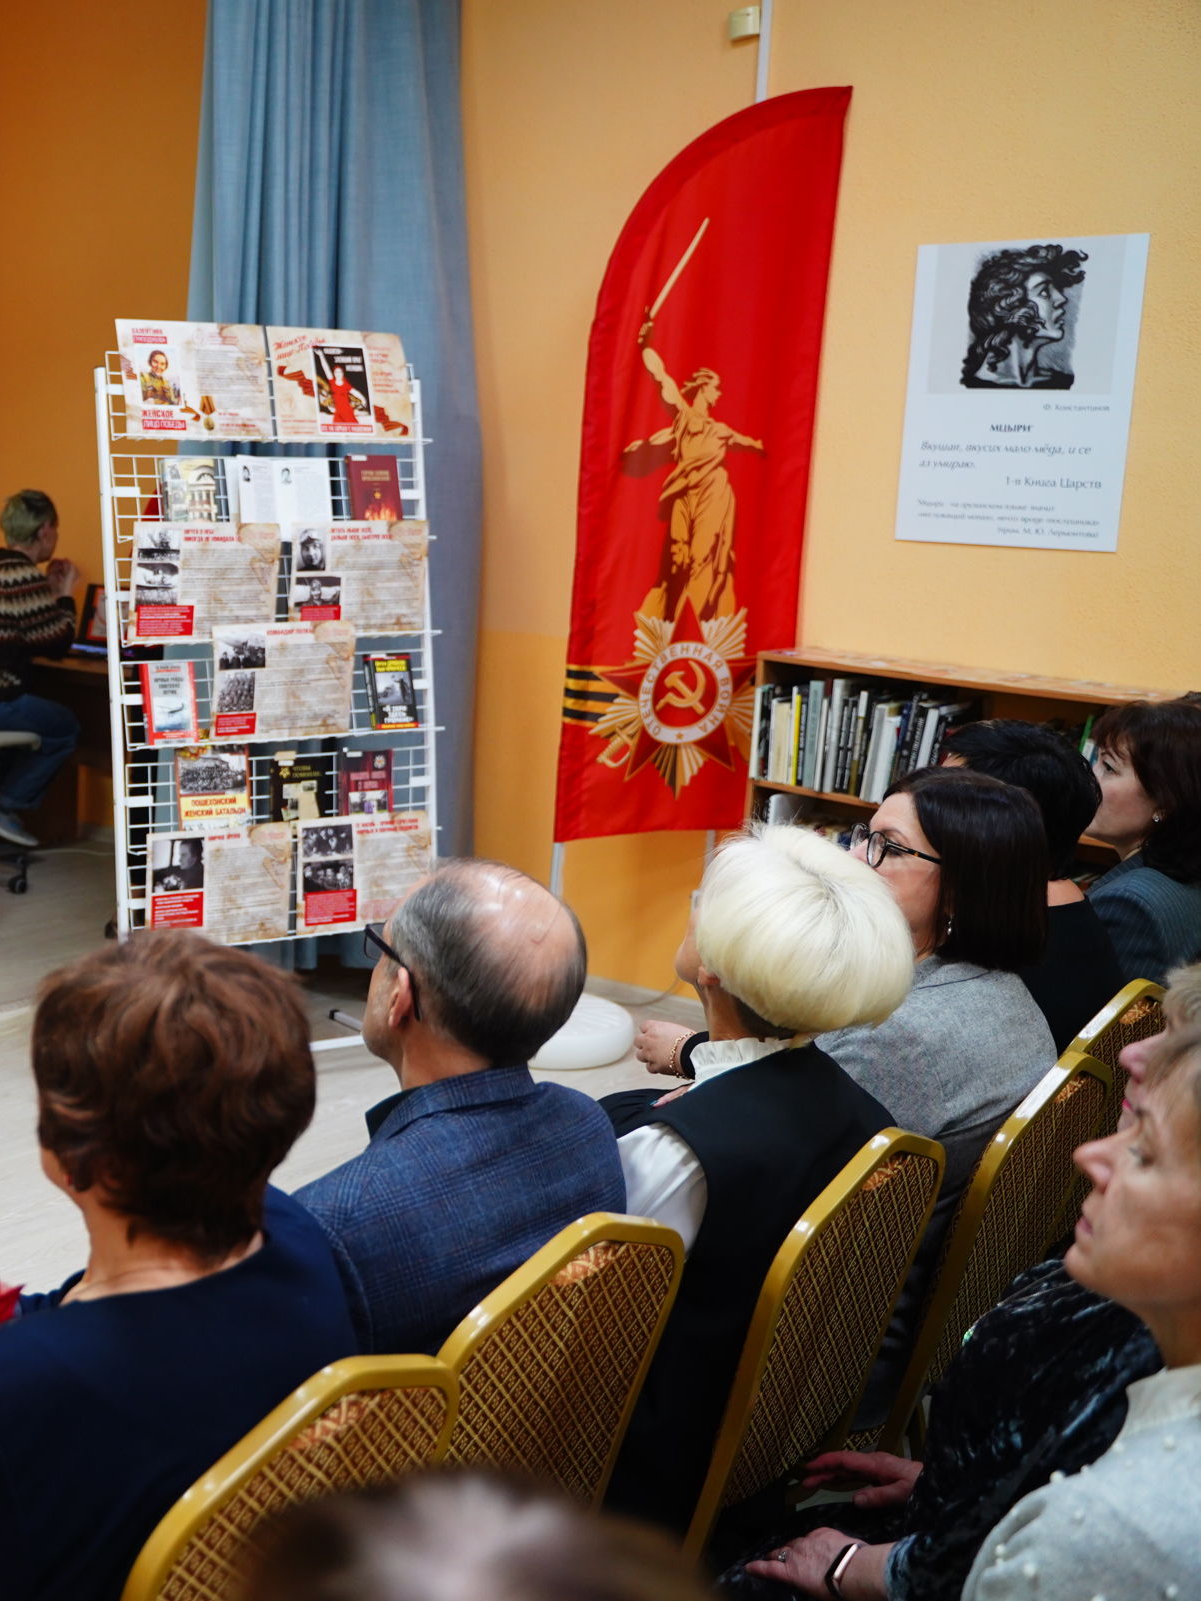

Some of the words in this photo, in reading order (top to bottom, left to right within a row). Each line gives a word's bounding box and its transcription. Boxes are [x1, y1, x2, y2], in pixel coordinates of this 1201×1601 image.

[142, 409, 174, 418] ЖЕНСКОЕ
[1060, 477, 1102, 492] Царств
[640, 645, 724, 736] ОТЕЧЕСТВЕННАЯ
[698, 677, 730, 733] ВОЙНА
[191, 796, 237, 806] ПОШЕХОНСКИЙ
[184, 809, 213, 817] ЖЕНСКИЙ
[216, 807, 246, 816] БАТАЛЬОН
